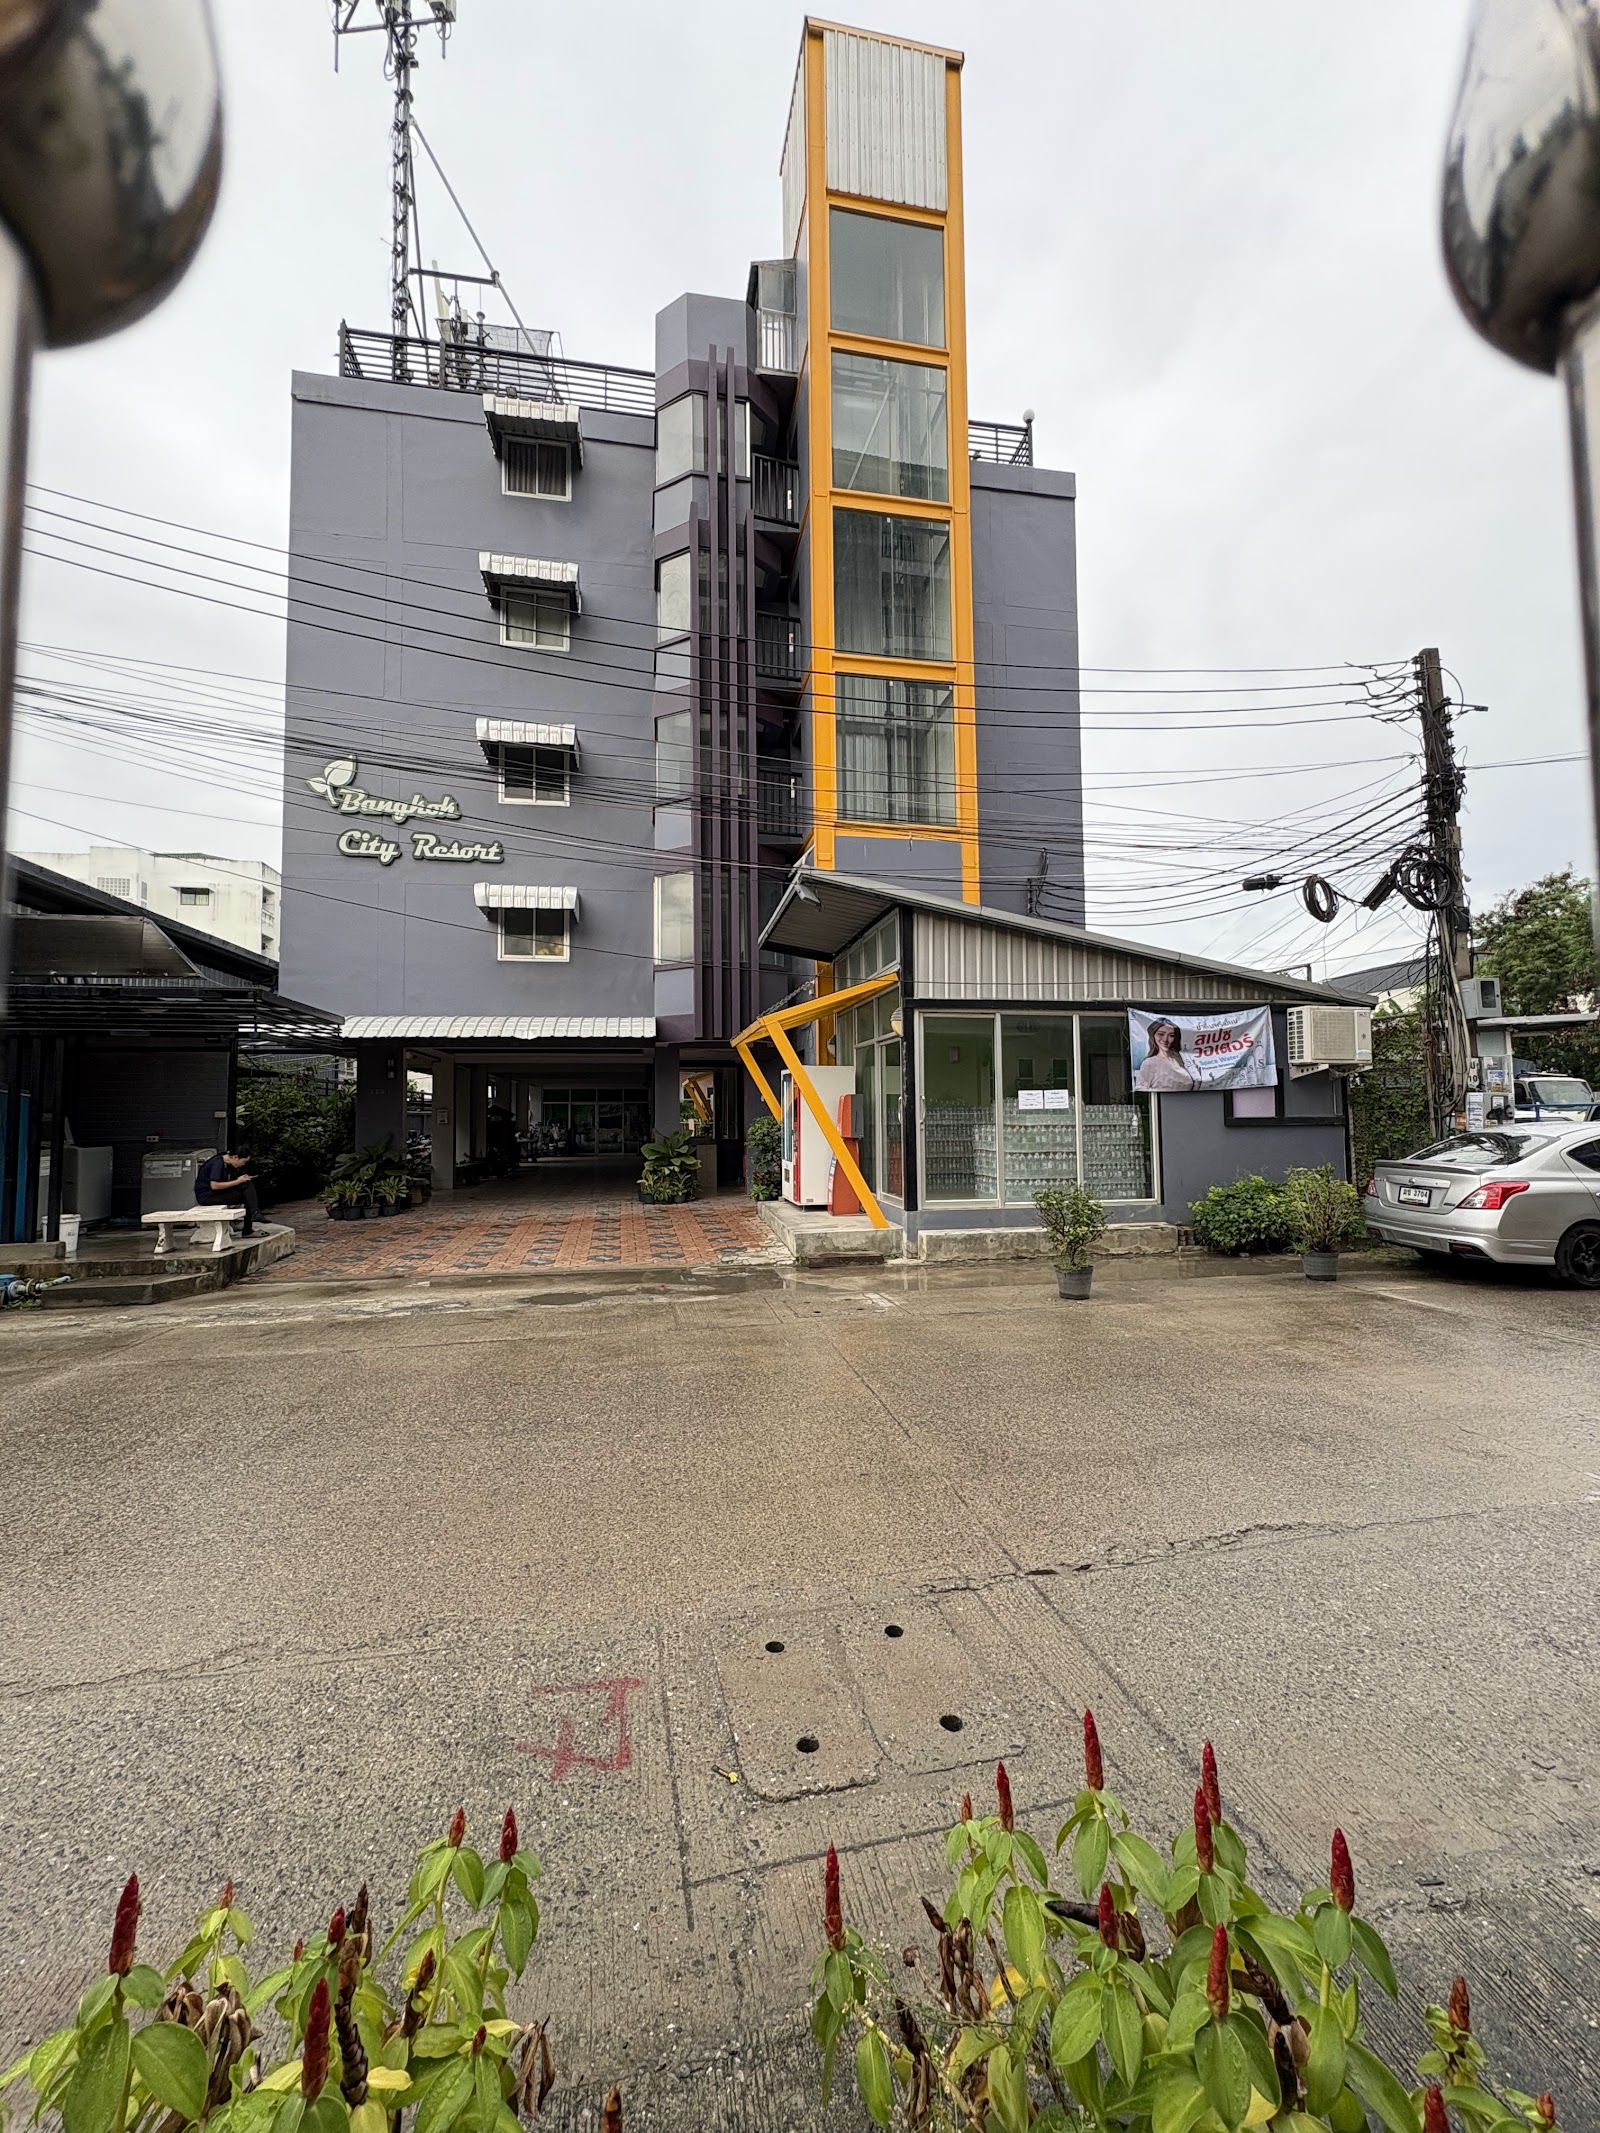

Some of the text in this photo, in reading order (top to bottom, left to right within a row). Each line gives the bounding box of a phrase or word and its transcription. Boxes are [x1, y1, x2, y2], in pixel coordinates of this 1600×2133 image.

[339, 788, 461, 820] Bangkok
[338, 830, 502, 863] City Resort
[1193, 1033, 1254, 1058] วอเตอร์
